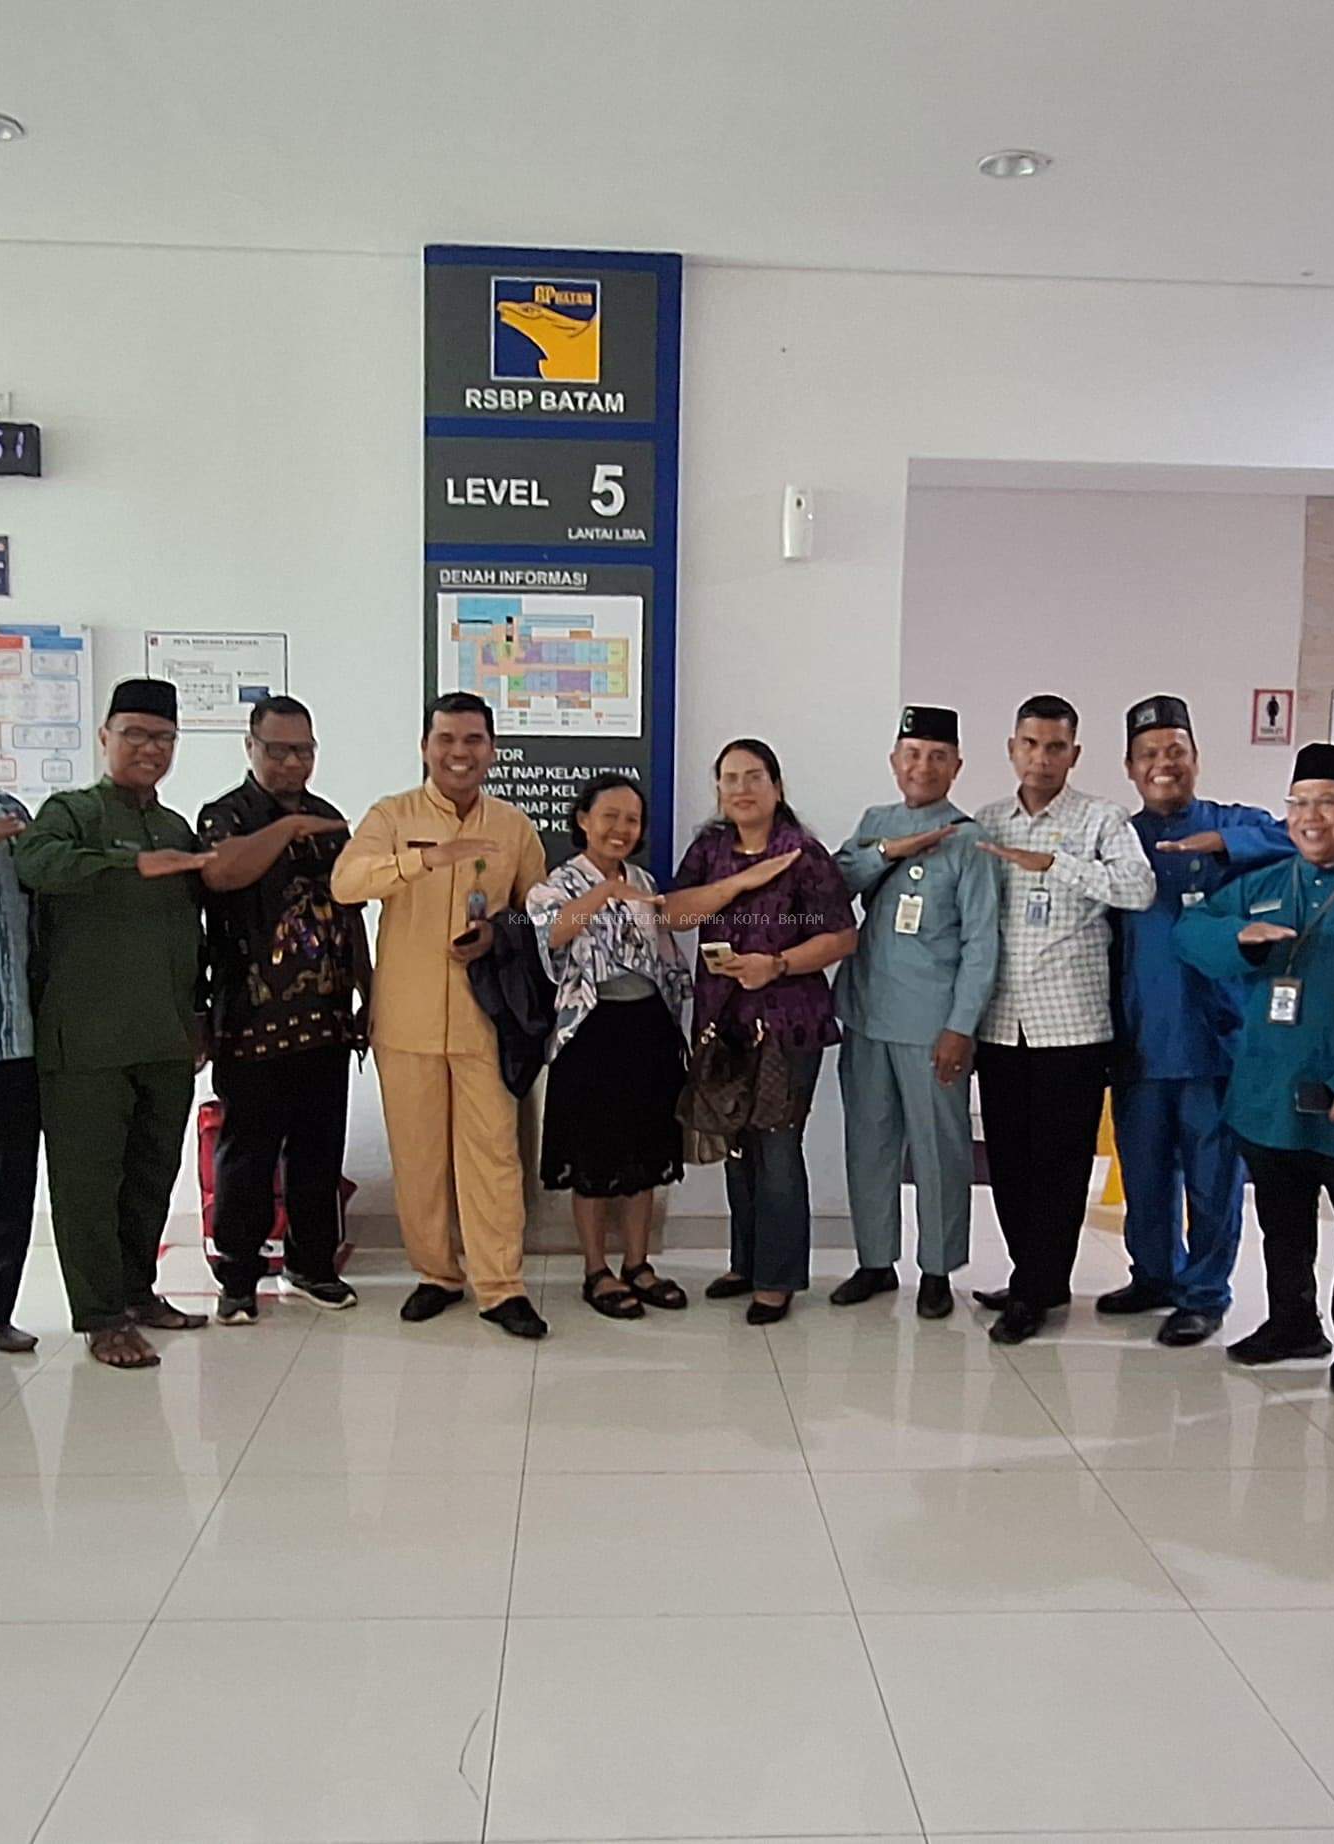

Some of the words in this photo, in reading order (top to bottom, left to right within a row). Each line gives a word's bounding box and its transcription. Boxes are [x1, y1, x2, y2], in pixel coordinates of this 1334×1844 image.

[465, 388, 533, 411] RSBP
[540, 390, 625, 413] BATAM
[445, 477, 550, 507] LEVEL
[590, 464, 626, 517] 5
[568, 528, 613, 540] LANTAI
[440, 569, 496, 585] DENAH
[499, 570, 587, 587] INFORMASI
[512, 766, 544, 779] INAP
[546, 767, 590, 780] KELAS
[517, 785, 549, 796] INAP
[552, 785, 578, 796] KEL
